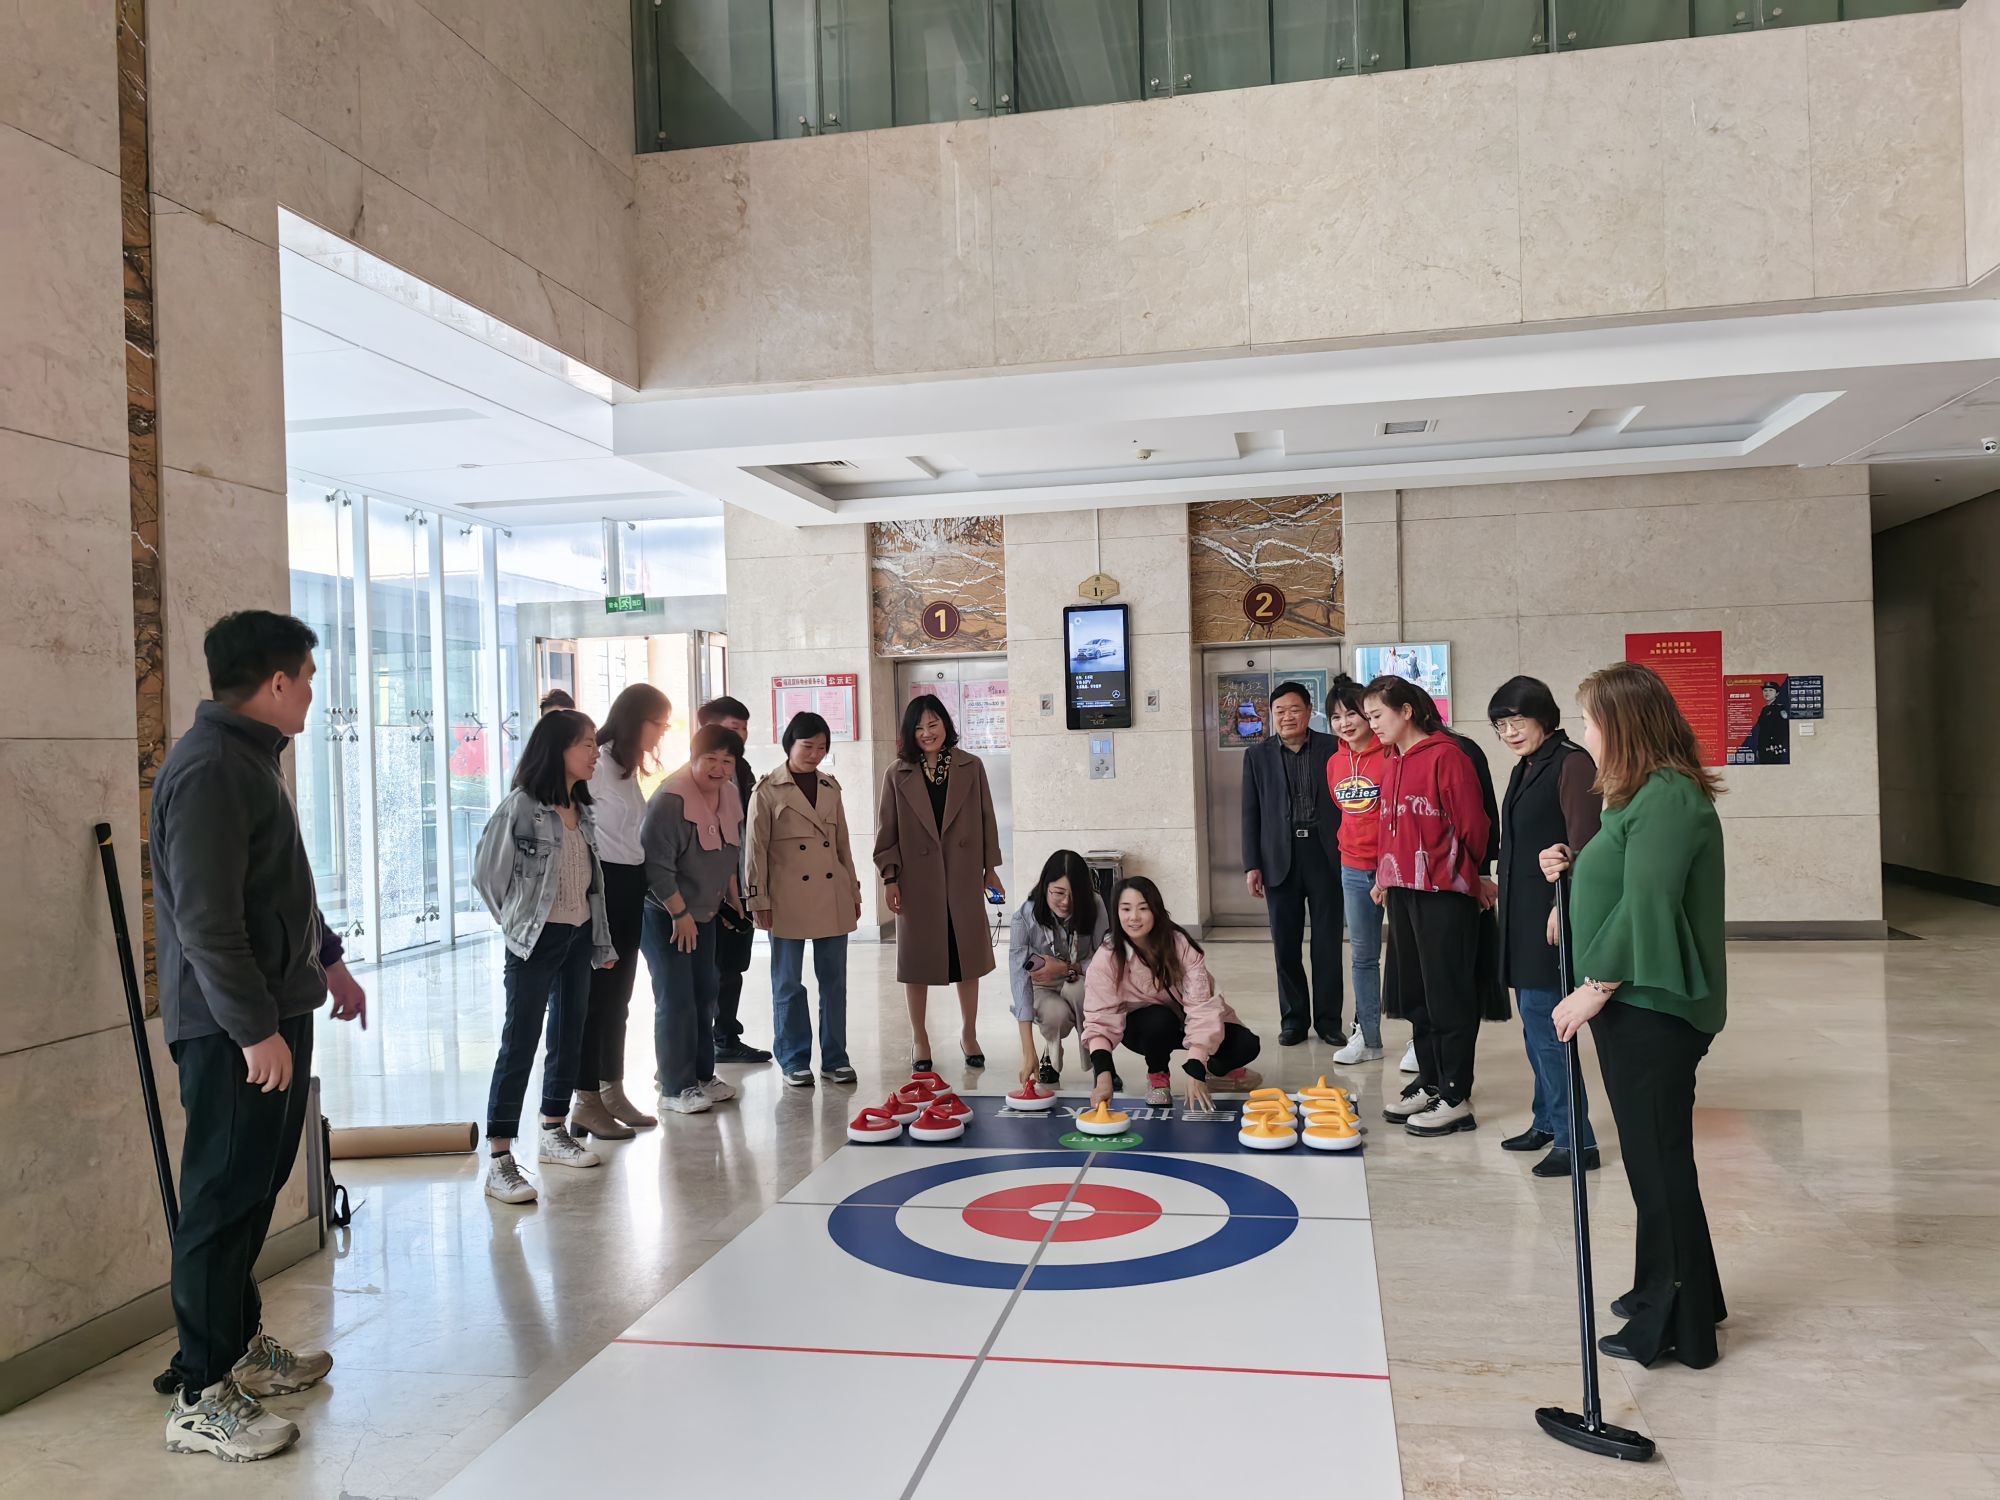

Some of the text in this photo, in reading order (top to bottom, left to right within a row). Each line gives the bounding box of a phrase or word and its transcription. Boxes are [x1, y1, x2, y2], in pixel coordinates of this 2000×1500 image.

[1256, 592, 1273, 617] 2
[935, 609, 946, 632] 1
[1336, 788, 1378, 800] Dickies
[1067, 1136, 1137, 1144] START
